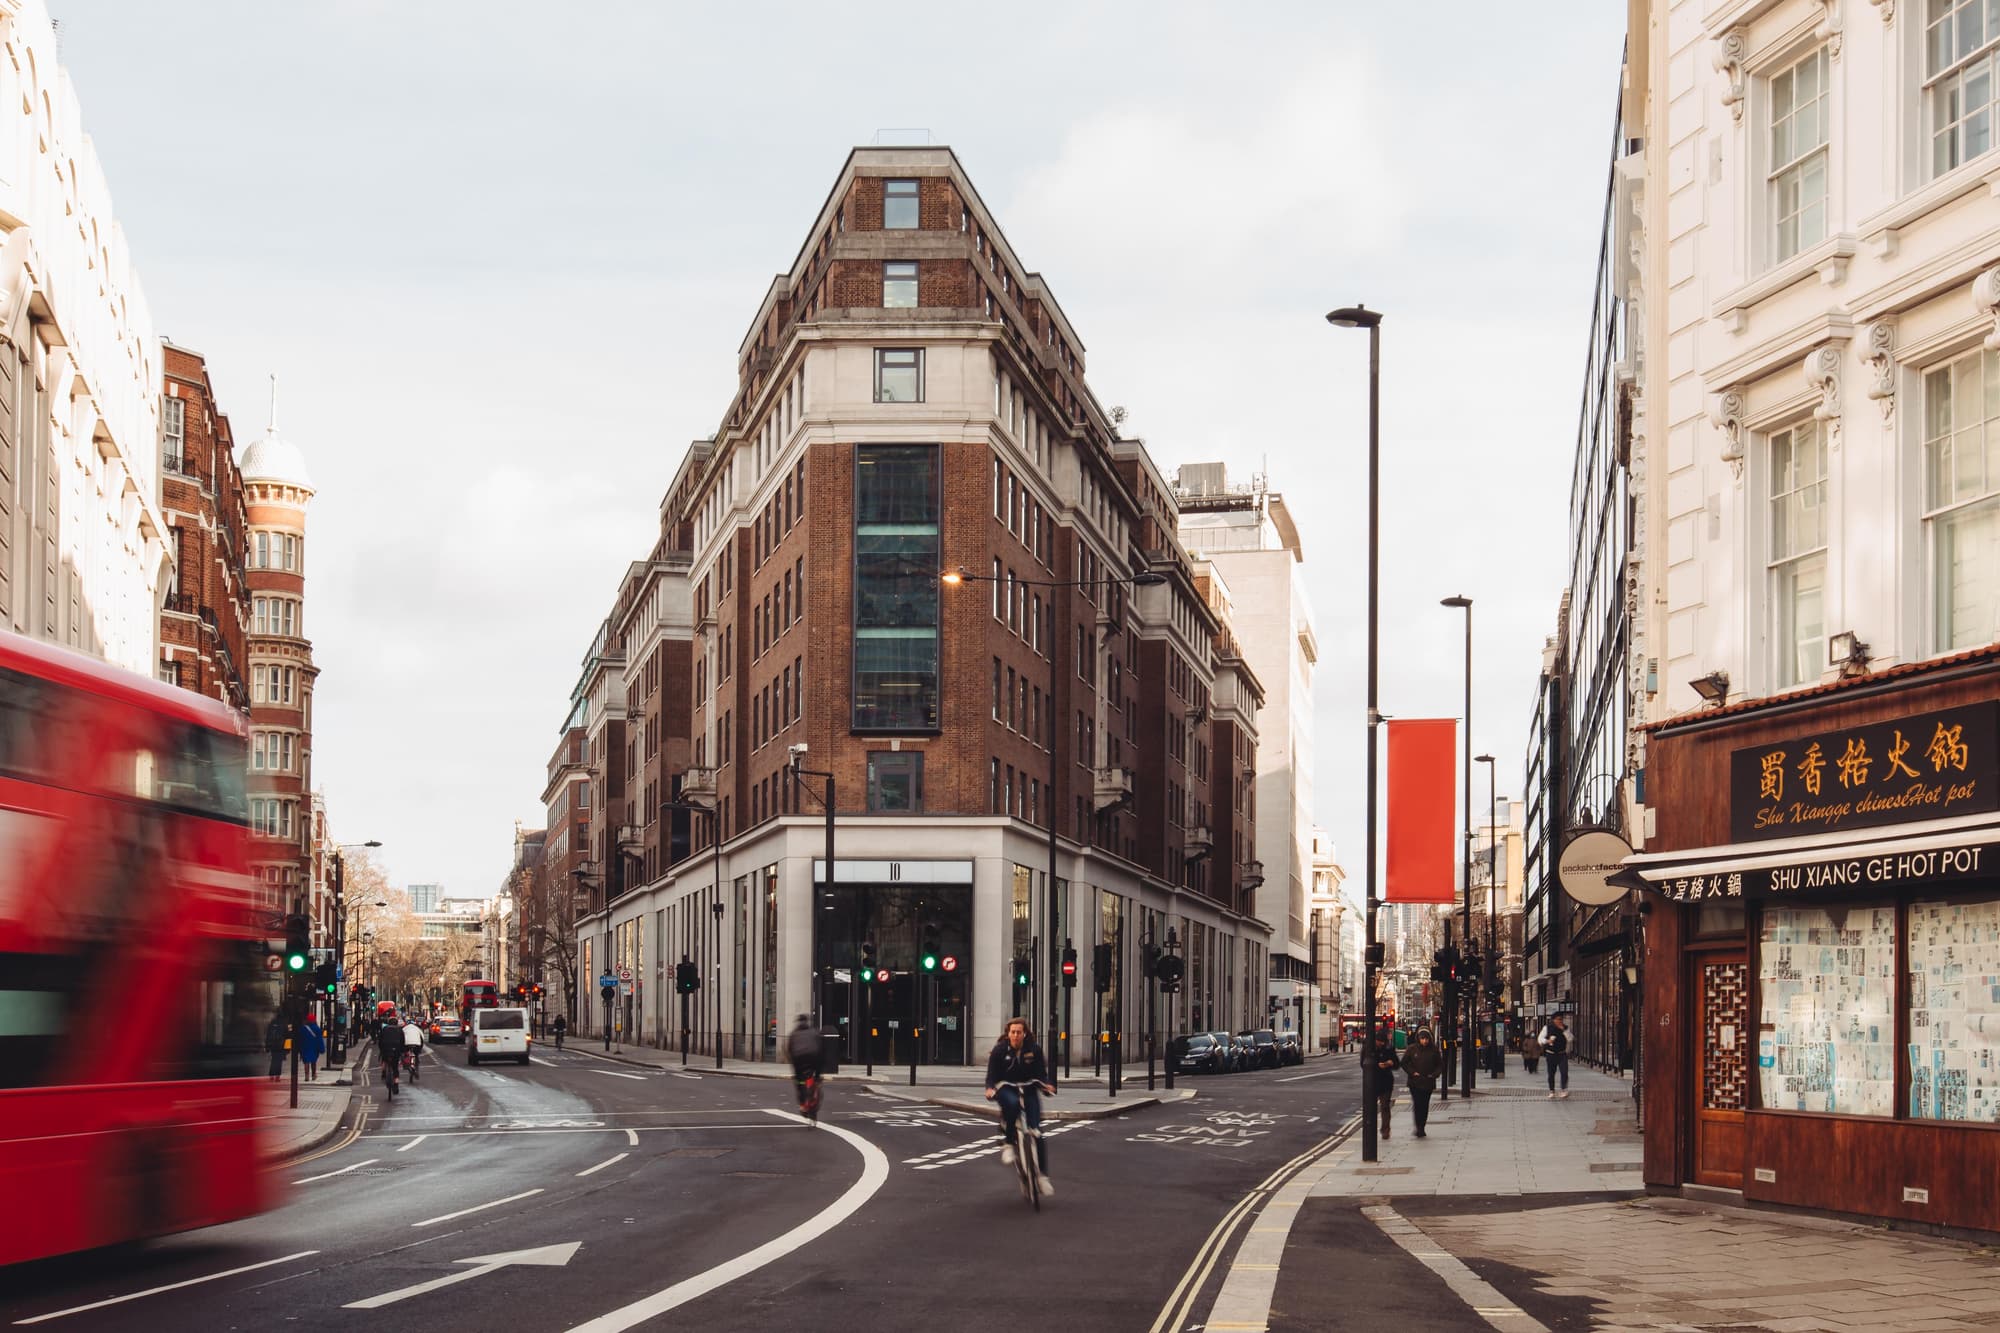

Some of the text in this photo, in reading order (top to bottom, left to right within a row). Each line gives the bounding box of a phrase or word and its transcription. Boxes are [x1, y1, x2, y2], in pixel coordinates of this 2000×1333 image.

[1754, 806, 1784, 829] Shu
[1946, 780, 1976, 804] pot
[889, 862, 901, 881] 10
[1562, 863, 1627, 874] packshotfacto
[1770, 848, 1982, 891] SHU XIANG GE HOT POT
[1155, 1124, 1272, 1137] AND
[1125, 1133, 1254, 1147] BUS
